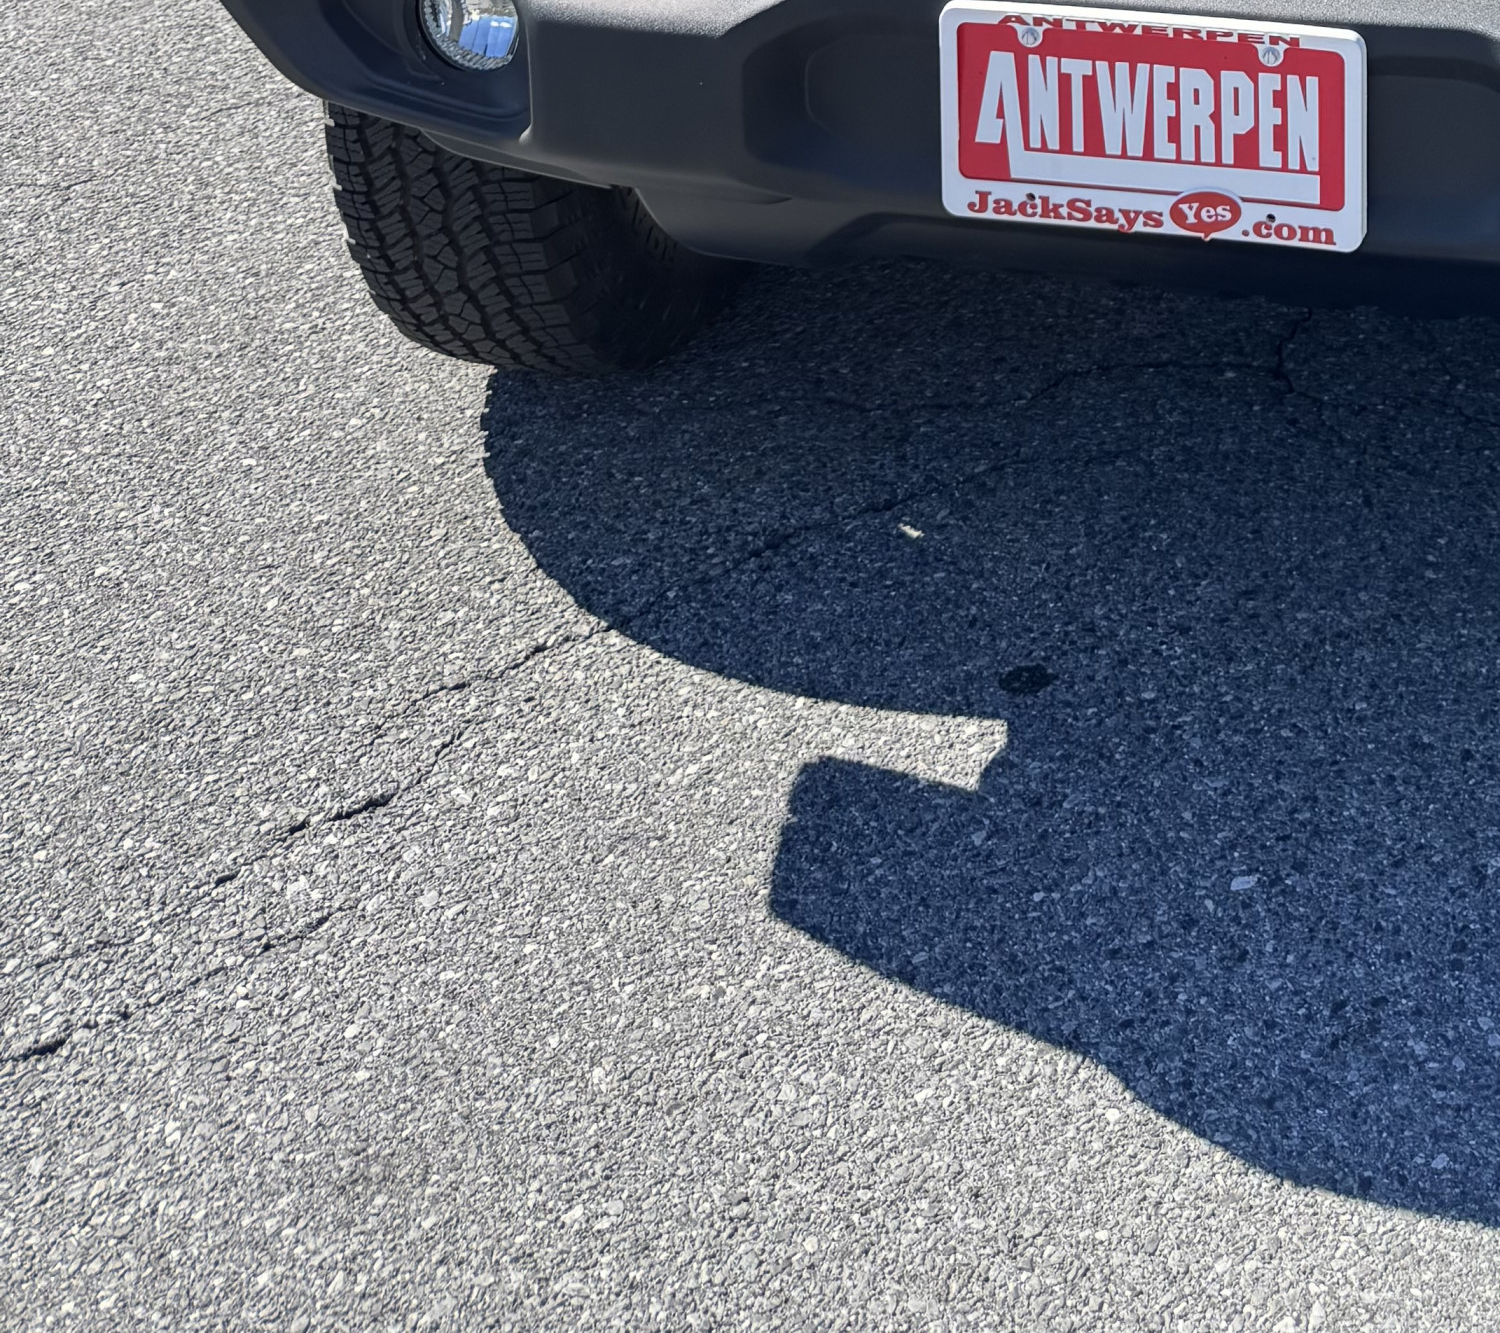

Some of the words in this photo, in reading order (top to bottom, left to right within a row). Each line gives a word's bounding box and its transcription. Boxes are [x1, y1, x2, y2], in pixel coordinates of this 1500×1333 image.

[997, 14, 1300, 47] ANTWERPEN
[974, 50, 1320, 173] ANTWERPEN
[967, 190, 1164, 232] JackSays
[1178, 201, 1232, 225] Yes
[1241, 219, 1337, 246] .com
